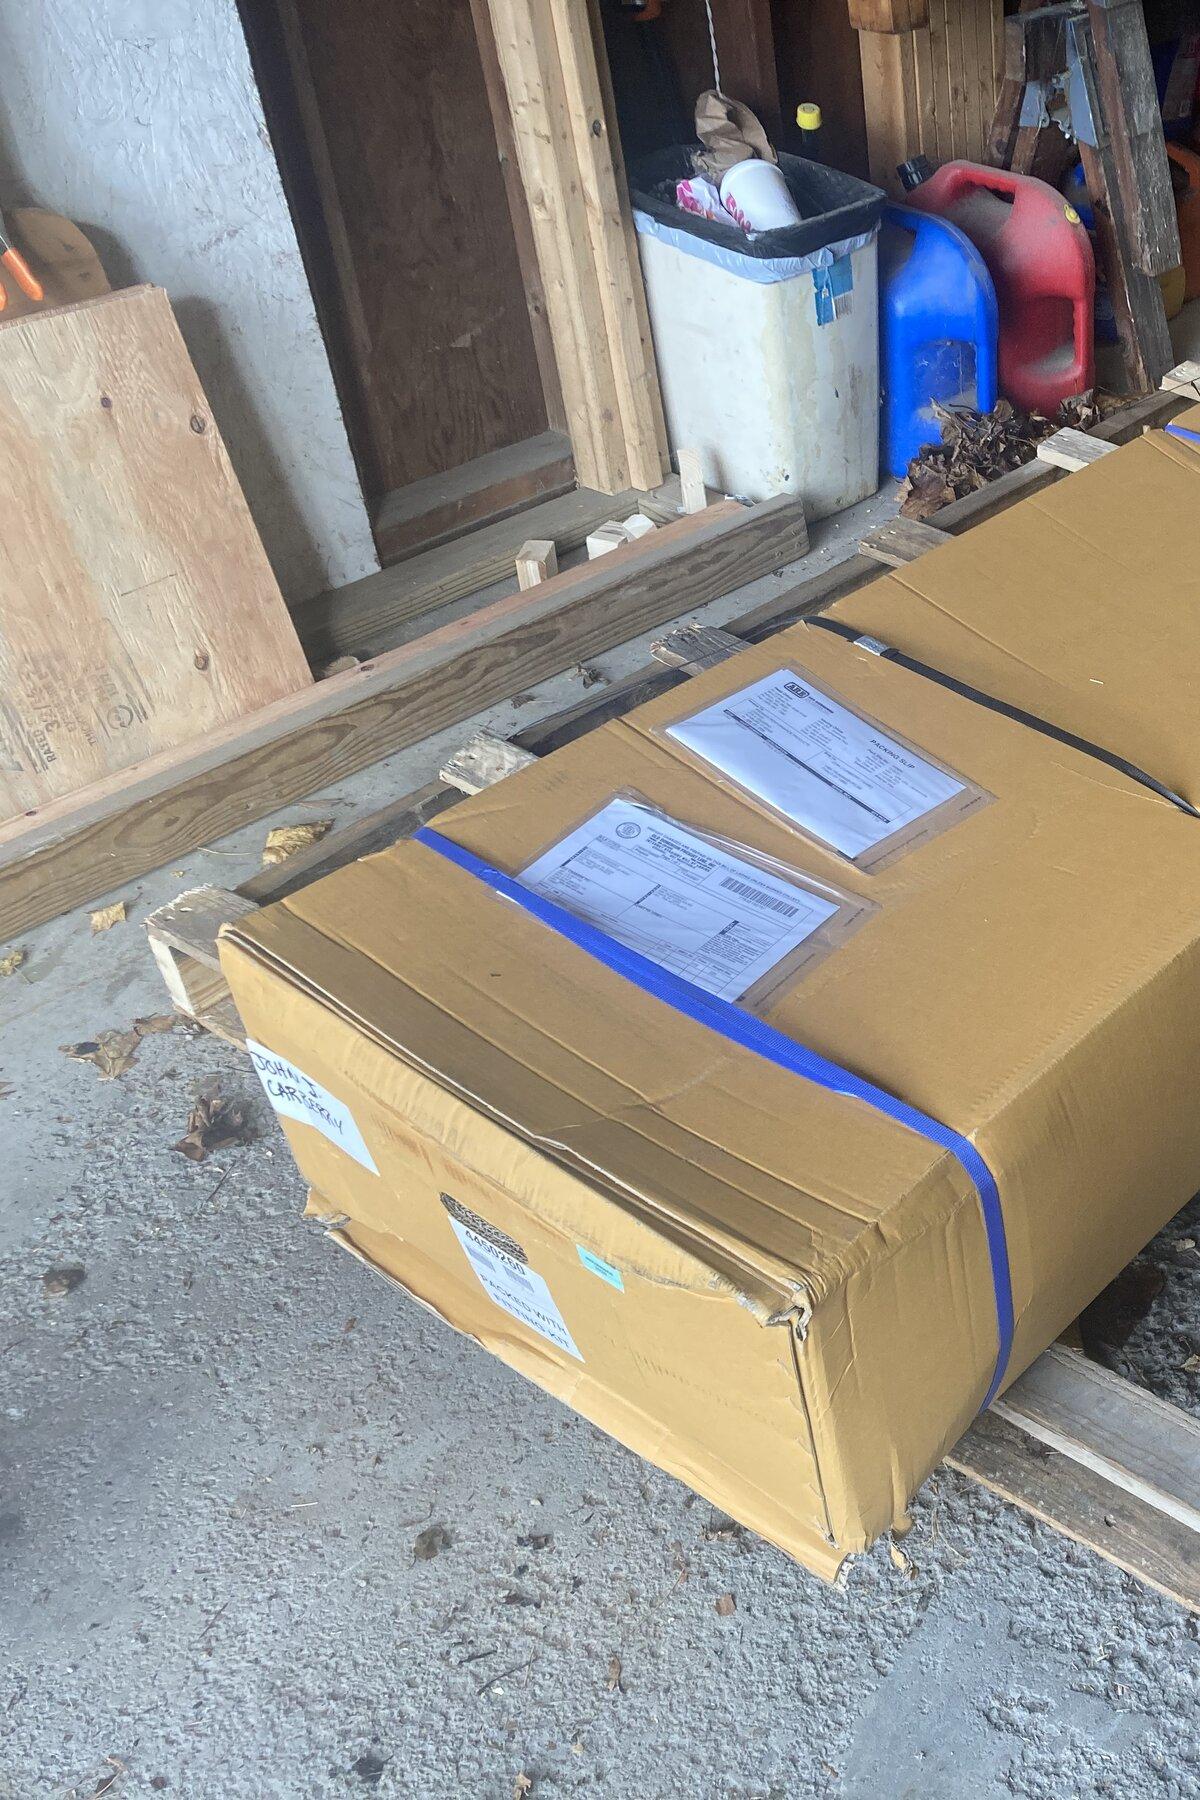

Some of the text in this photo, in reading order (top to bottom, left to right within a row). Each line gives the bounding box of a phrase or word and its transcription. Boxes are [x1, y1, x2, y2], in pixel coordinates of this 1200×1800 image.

[33, 729, 57, 763] RATED
[869, 739, 915, 769] PACKING SLIP
[250, 1051, 299, 1083] JOHN
[465, 1230, 526, 1276] 4450260
[479, 1272, 567, 1335] PACKED WITH
[493, 1292, 570, 1348] FITTING KIT
